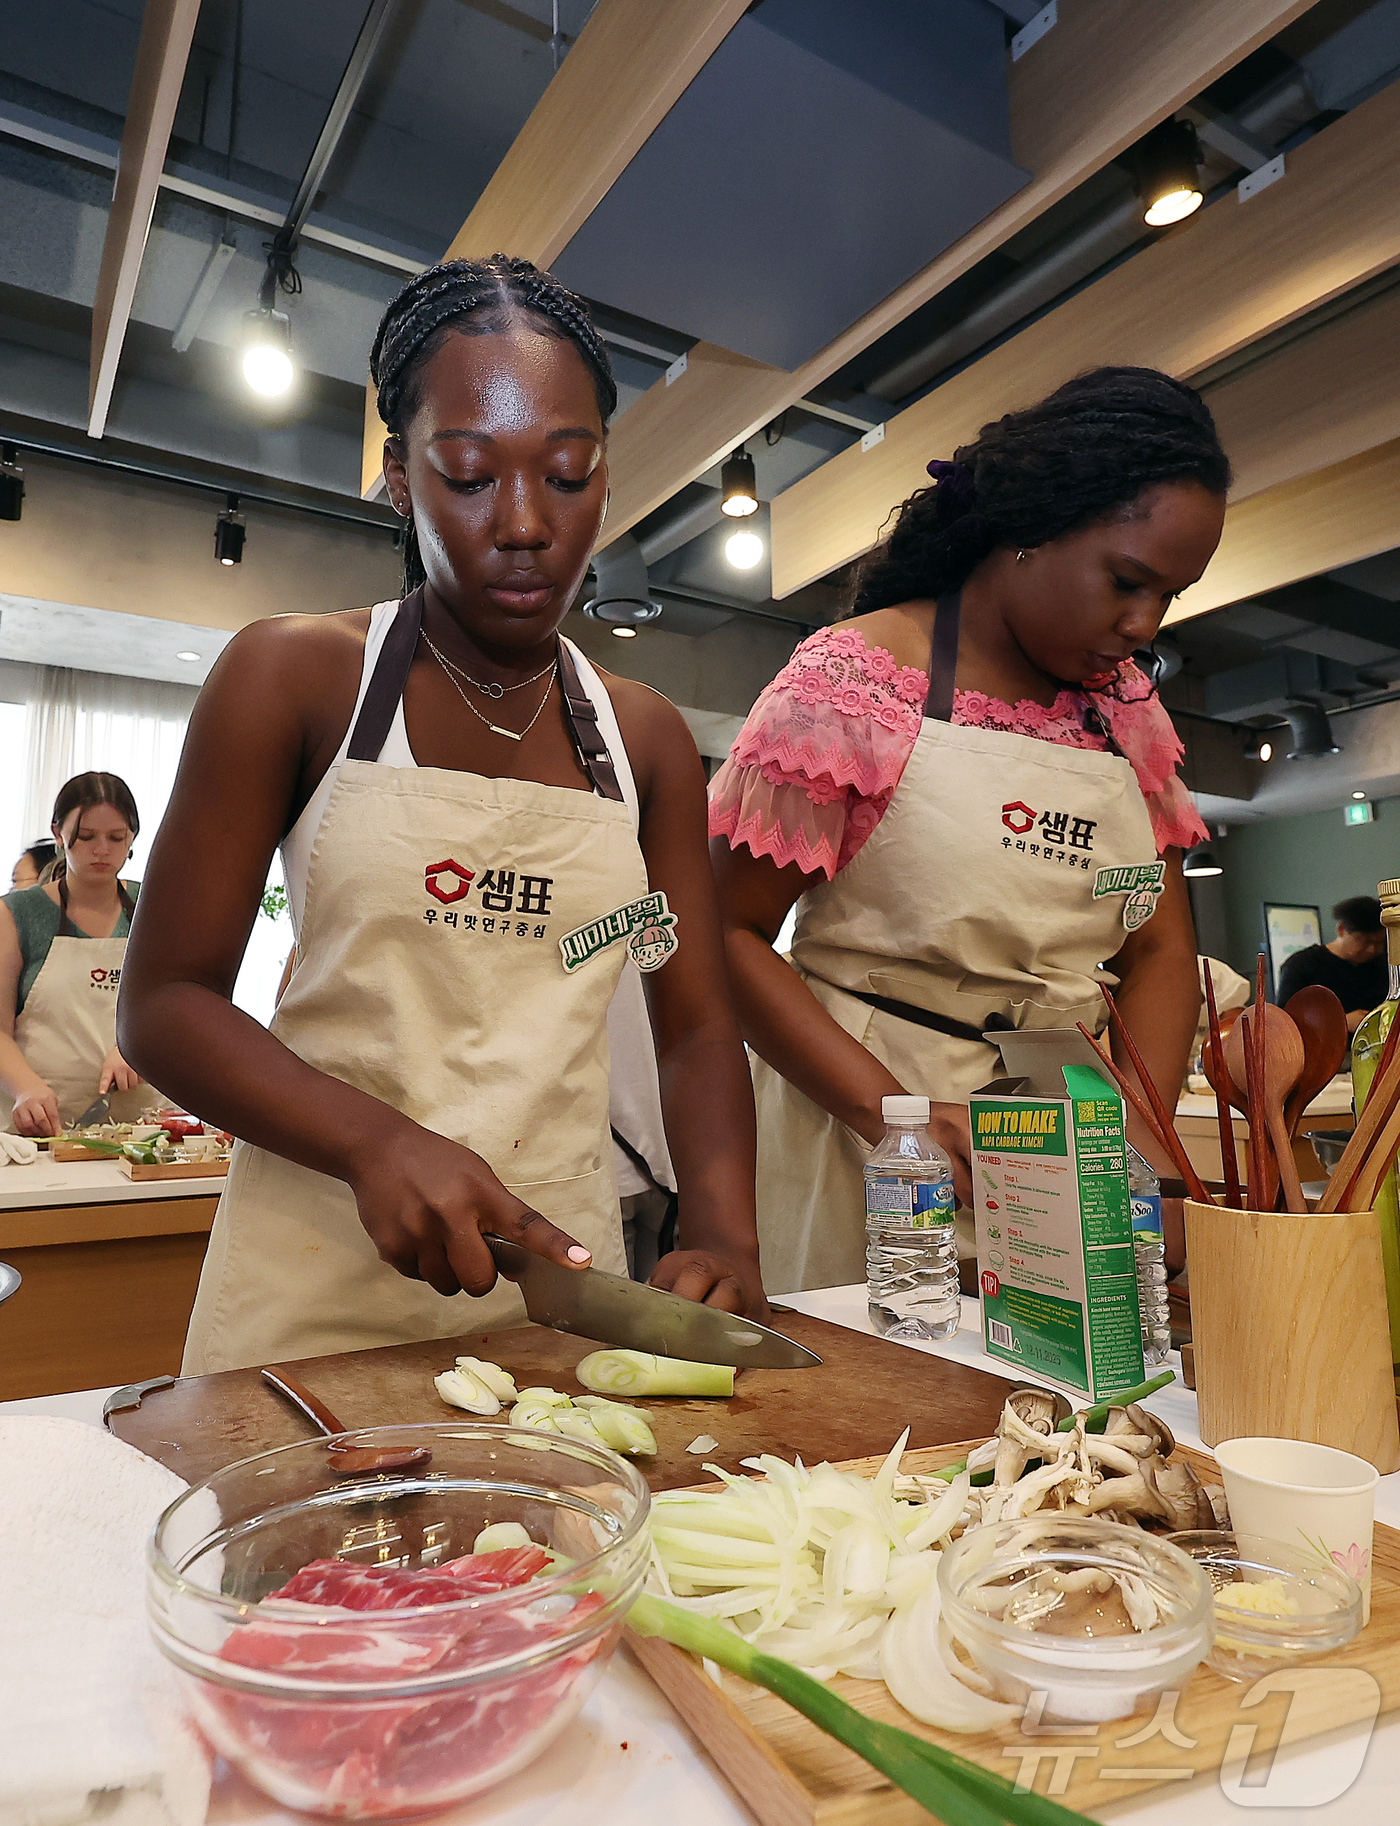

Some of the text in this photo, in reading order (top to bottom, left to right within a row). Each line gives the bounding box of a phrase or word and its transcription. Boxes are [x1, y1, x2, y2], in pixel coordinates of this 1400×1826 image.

[1038, 811, 1097, 851] 샘표
[476, 869, 554, 916] 샘표
[109, 969, 121, 984] 샘
[978, 1109, 1058, 1134] HOW TO MAKE
[1077, 1125, 1121, 1138] Nutrition Facts
[981, 1136, 1044, 1148] NAPA CABBAGE KIMCHI
[976, 1154, 988, 1163] YOU
[988, 1155, 1002, 1165] NEED
[1080, 1162, 1104, 1172] Calories
[1109, 1158, 1123, 1170] 280
[1004, 1174, 1015, 1182] Step
[1005, 1193, 1016, 1202] Step
[1007, 1227, 1018, 1237] Step
[1009, 1256, 1020, 1265] Step
[1090, 1294, 1127, 1303] INGREDIENTS
